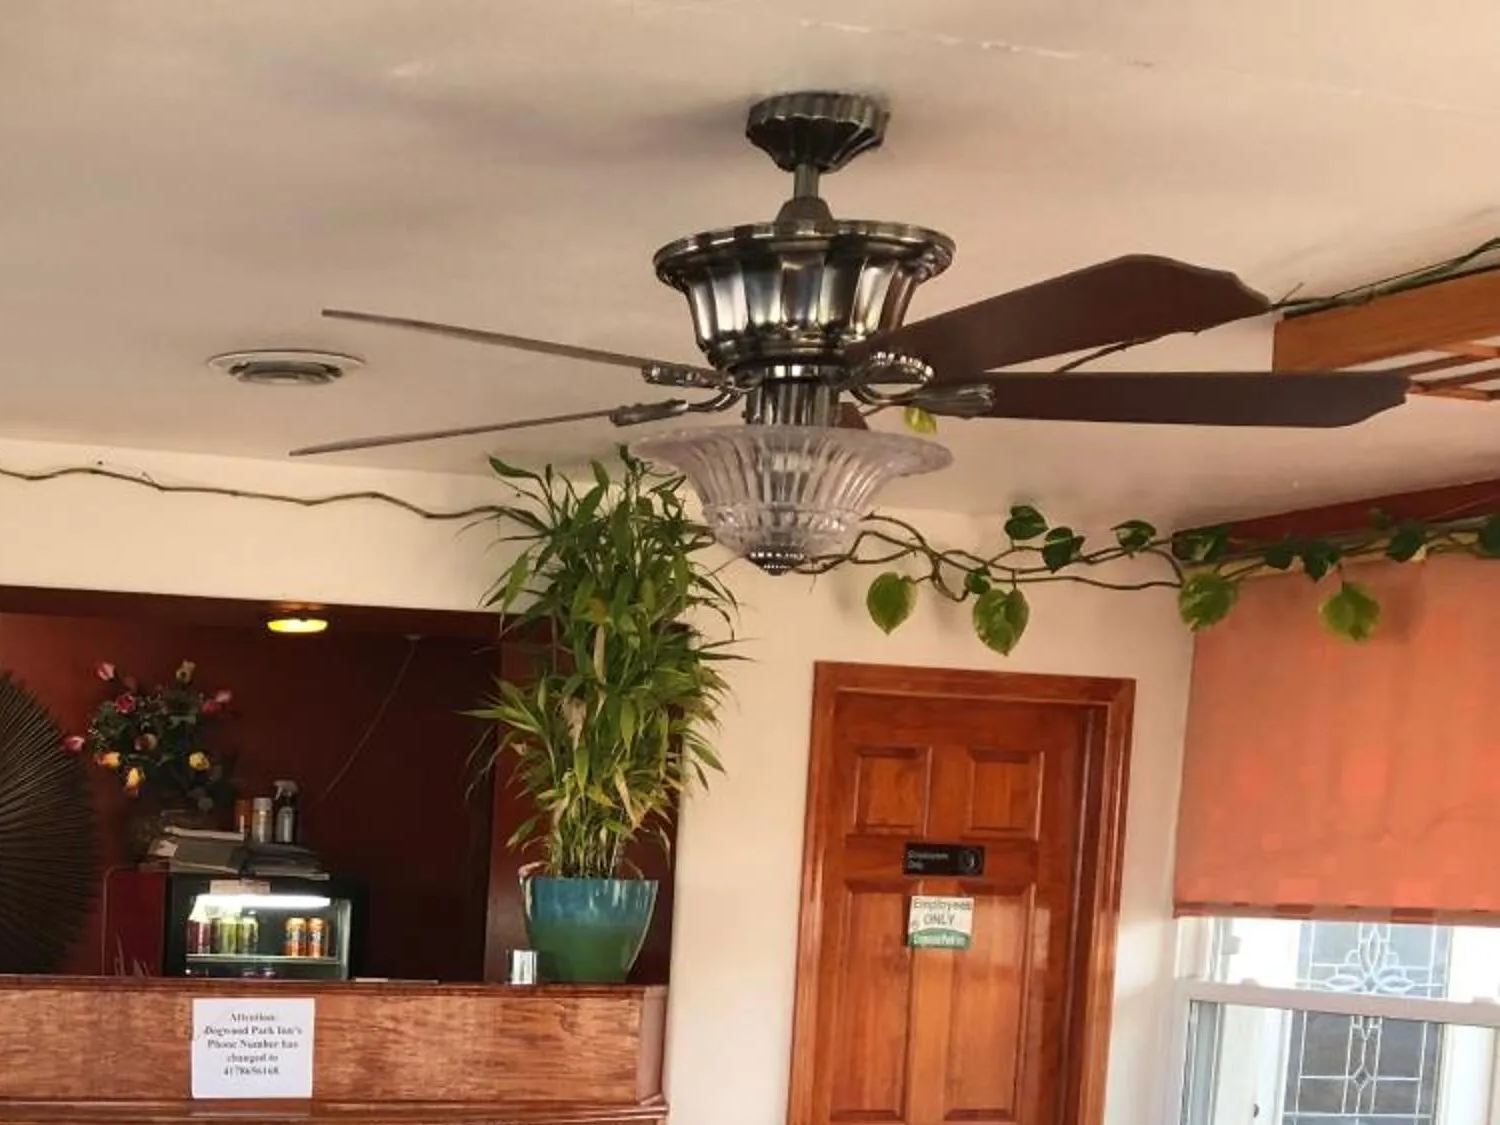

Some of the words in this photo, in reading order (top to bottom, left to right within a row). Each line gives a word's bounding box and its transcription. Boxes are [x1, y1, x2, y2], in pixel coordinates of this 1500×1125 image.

[923, 914, 956, 925] ONLY
[203, 1025, 249, 1037] Dogwood
[251, 1025, 275, 1035] Park
[277, 1025, 303, 1035] Inn's
[207, 1039, 238, 1049] Phone
[240, 1039, 279, 1049] Number
[281, 1039, 299, 1049] has
[227, 1052, 266, 1064] changed
[268, 1053, 279, 1062] to
